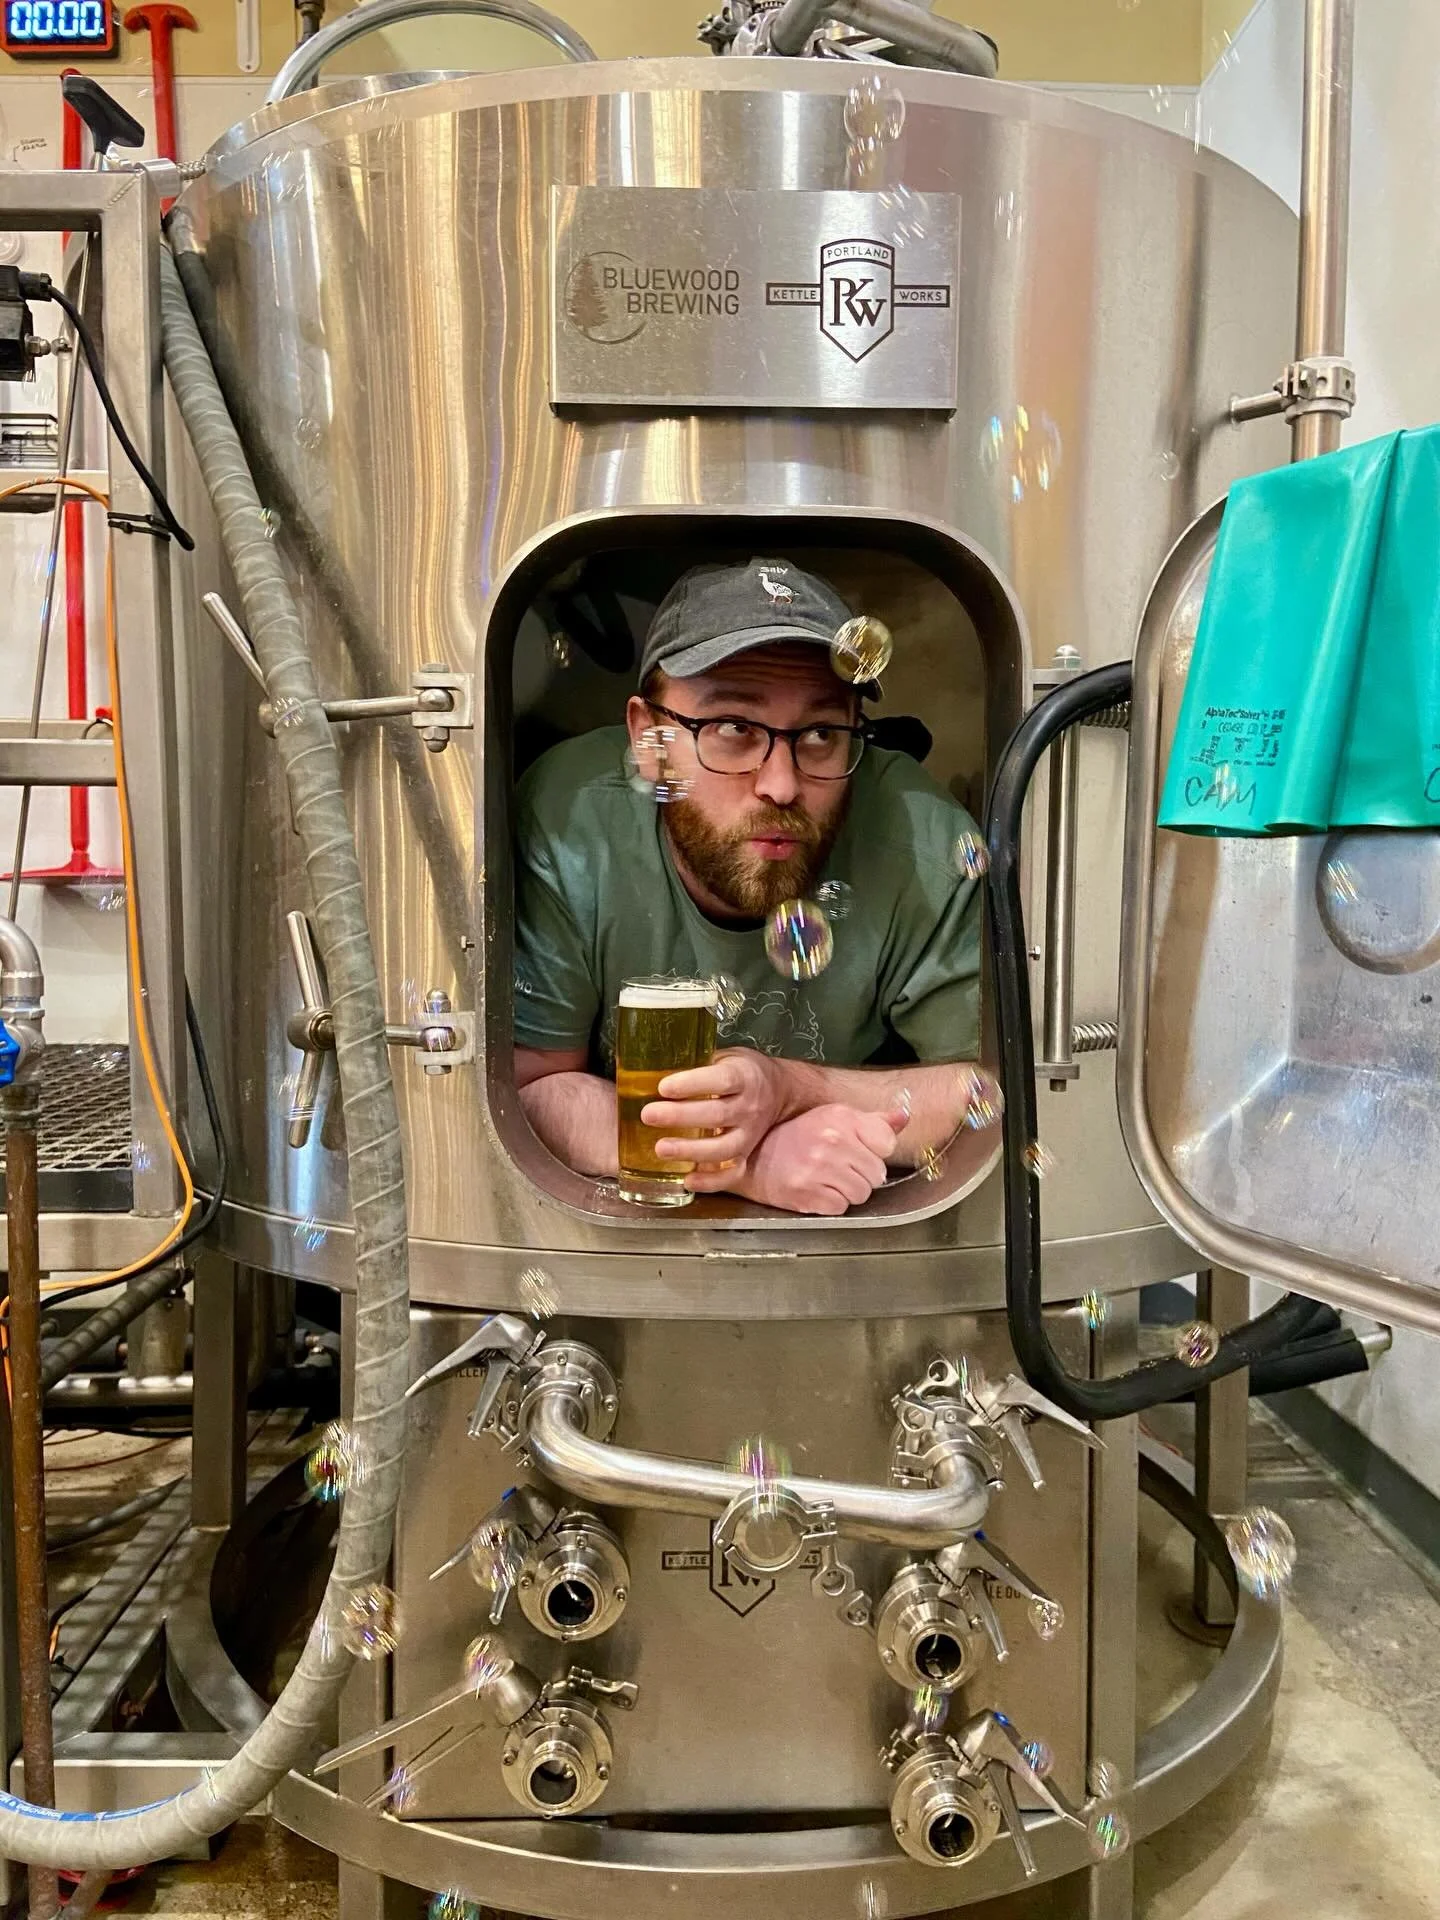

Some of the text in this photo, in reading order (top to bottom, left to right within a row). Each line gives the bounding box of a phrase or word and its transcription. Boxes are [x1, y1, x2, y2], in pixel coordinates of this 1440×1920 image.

[827, 246, 889, 259] PORTLAND
[603, 267, 740, 291] BLUEWOOD
[627, 292, 740, 315] BREWING
[773, 290, 942, 301] KETTLE WORKS
